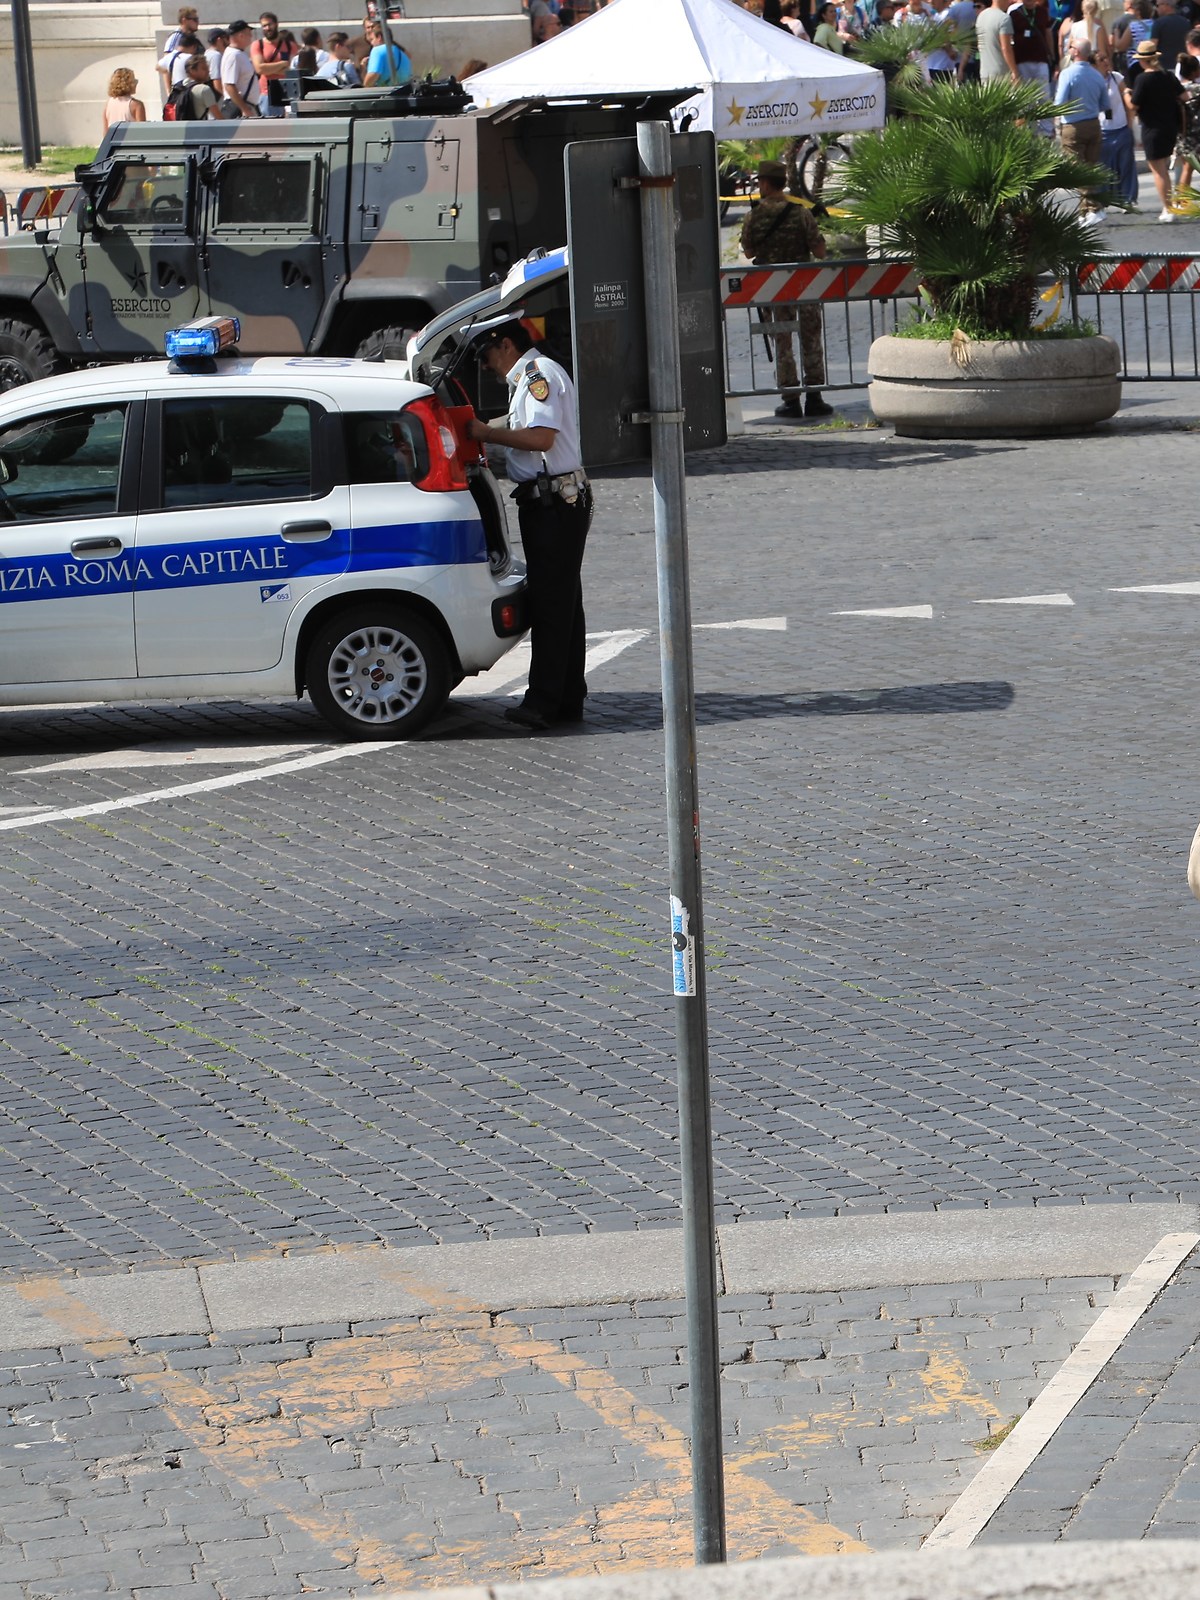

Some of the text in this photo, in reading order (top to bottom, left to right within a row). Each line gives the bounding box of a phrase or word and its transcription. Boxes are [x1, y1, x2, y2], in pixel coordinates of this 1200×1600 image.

[745, 102, 799, 119] ESERCITO
[827, 94, 877, 113] ESERCITO
[111, 298, 171, 312] ESERCITO
[595, 292, 626, 302] ASTRAL
[63, 558, 154, 586] ROMA
[161, 546, 289, 577] CAPITALE
